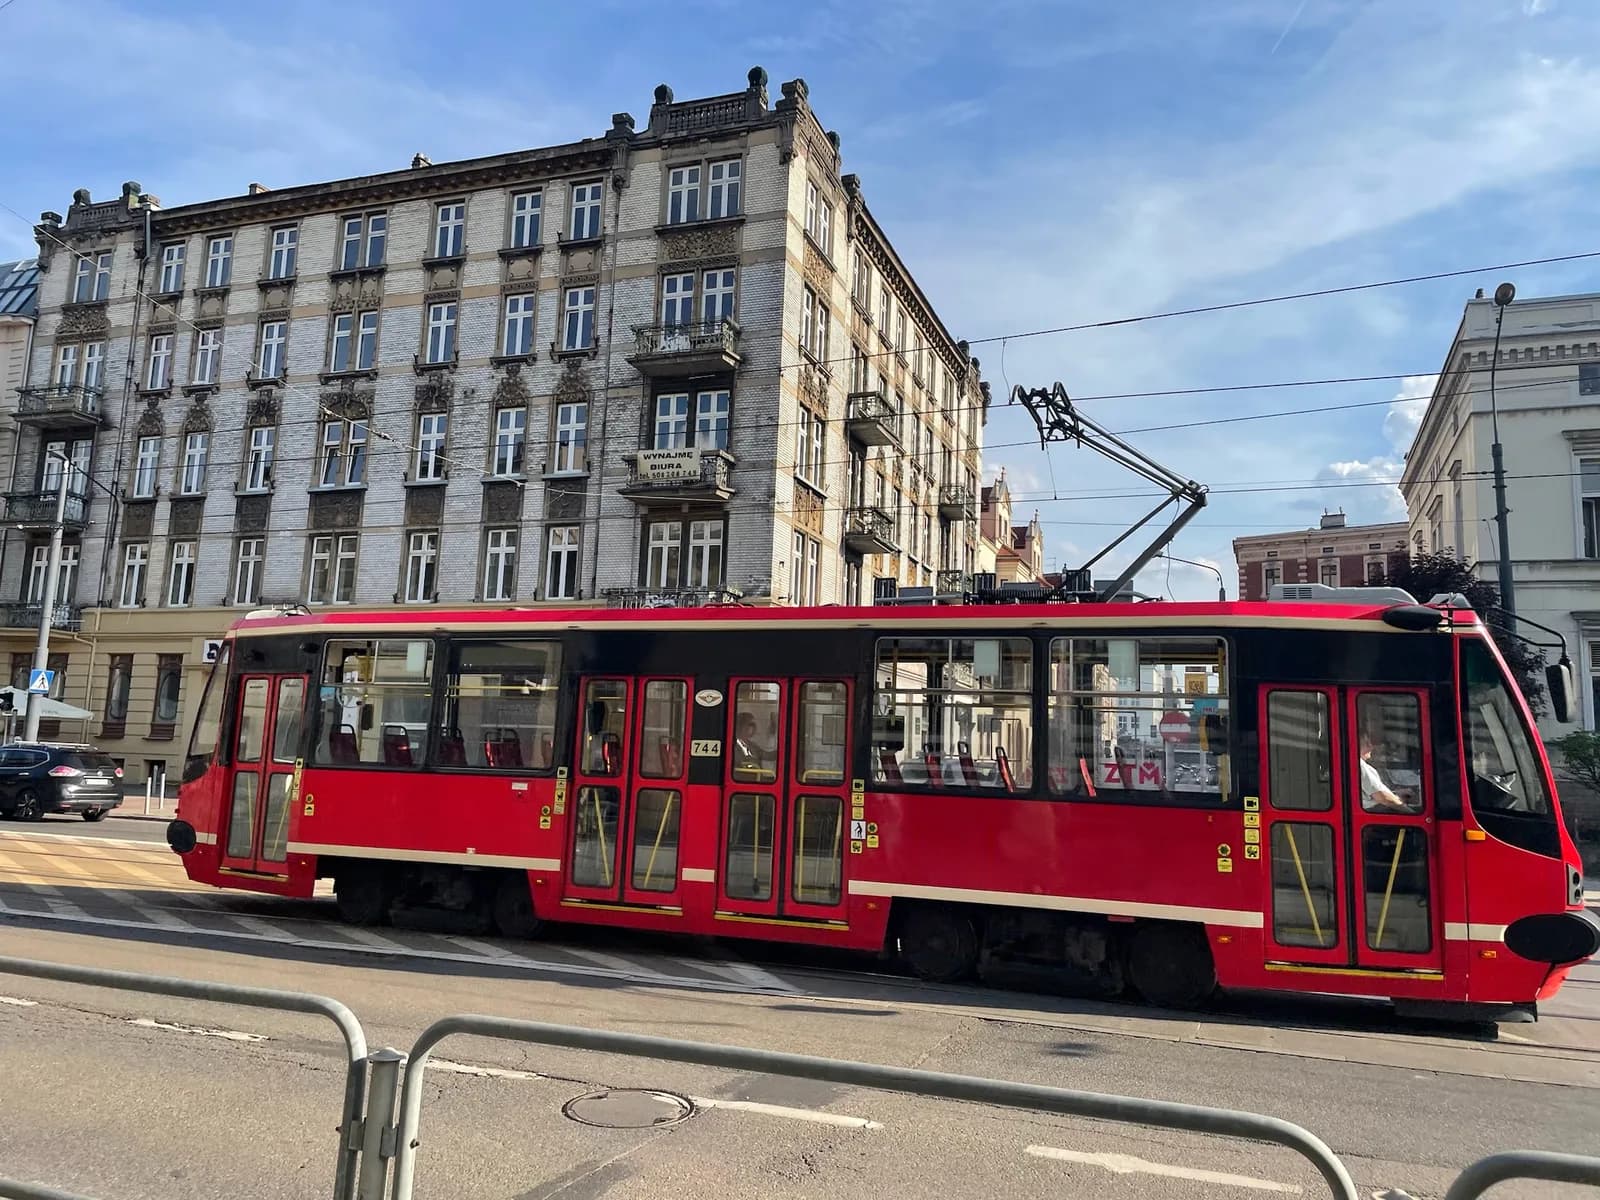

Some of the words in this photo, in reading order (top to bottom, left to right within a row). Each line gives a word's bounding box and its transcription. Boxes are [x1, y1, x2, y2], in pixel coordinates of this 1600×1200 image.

[643, 451, 693, 460] WYNAJMĘ
[694, 743, 719, 753] 744
[1104, 762, 1160, 784] ZTM
